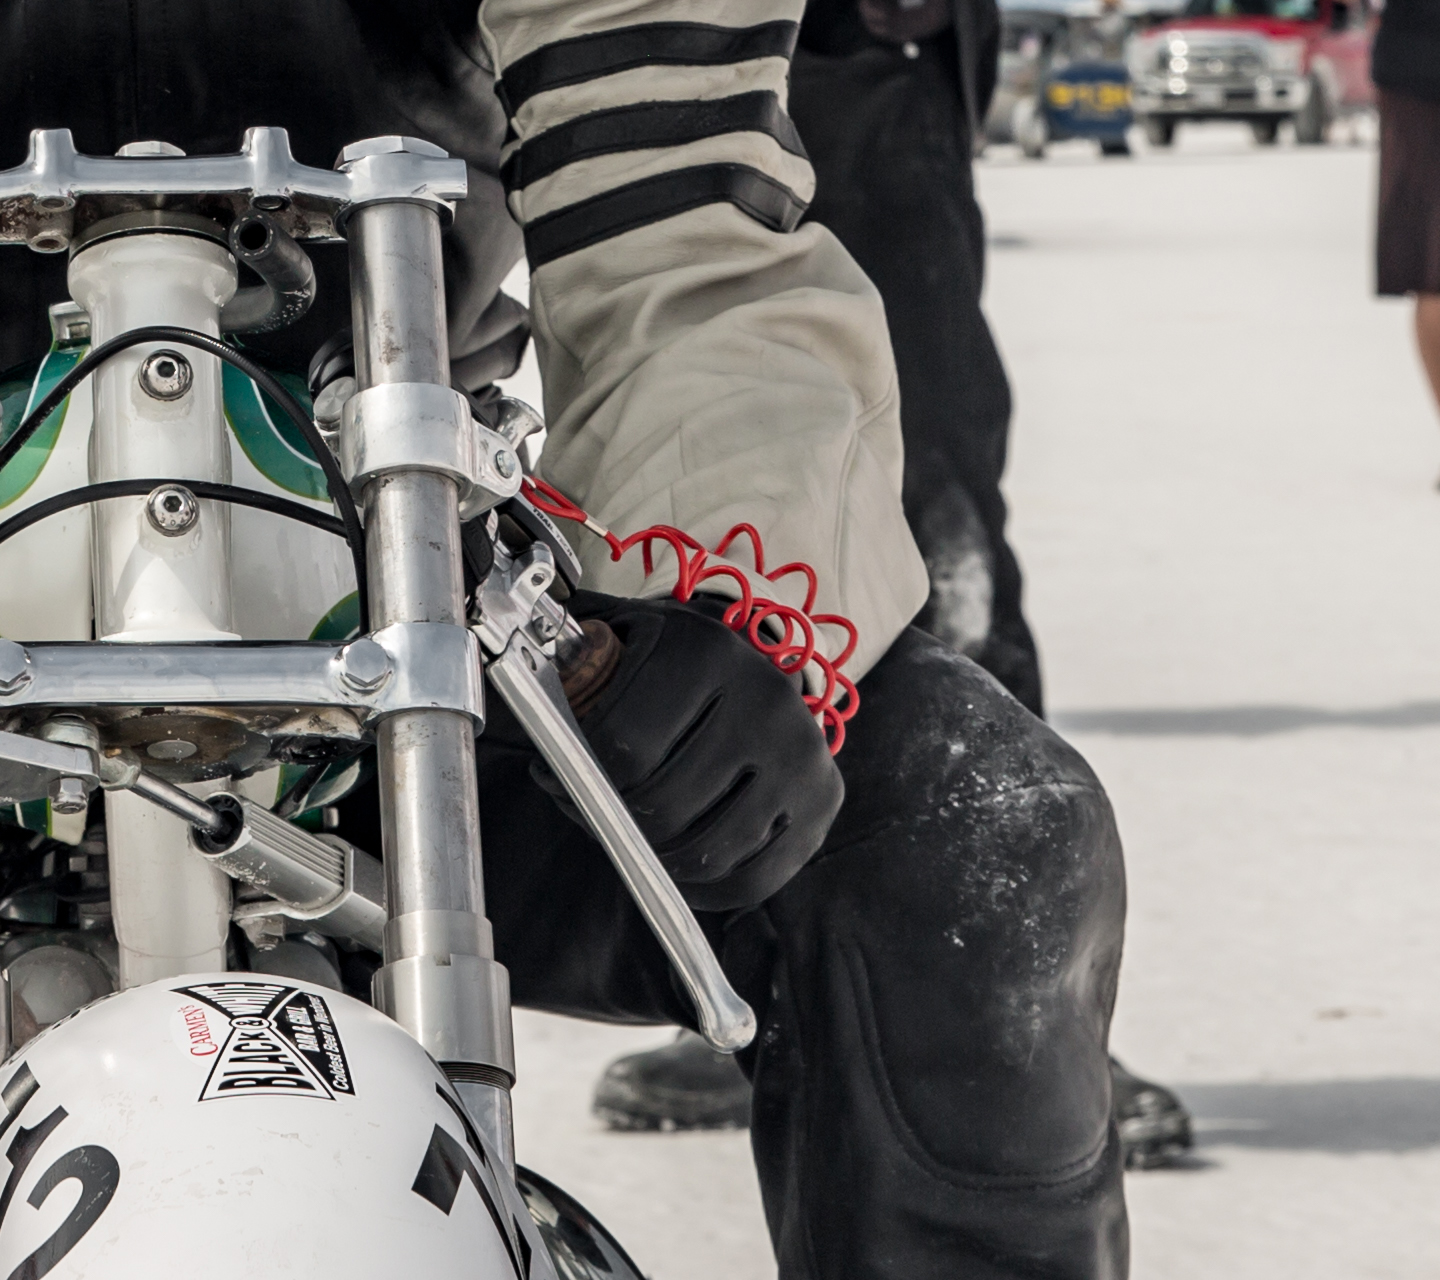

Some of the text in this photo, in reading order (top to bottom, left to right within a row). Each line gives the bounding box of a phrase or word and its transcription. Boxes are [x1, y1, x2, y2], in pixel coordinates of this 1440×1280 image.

[186, 983, 317, 1091] BLACK & WHITE
[291, 1025, 316, 1034] &
[317, 1023, 334, 1034] in
[294, 1032, 321, 1053] BAR
[322, 1031, 340, 1054] Beer
[326, 1051, 350, 1091] Coldest
